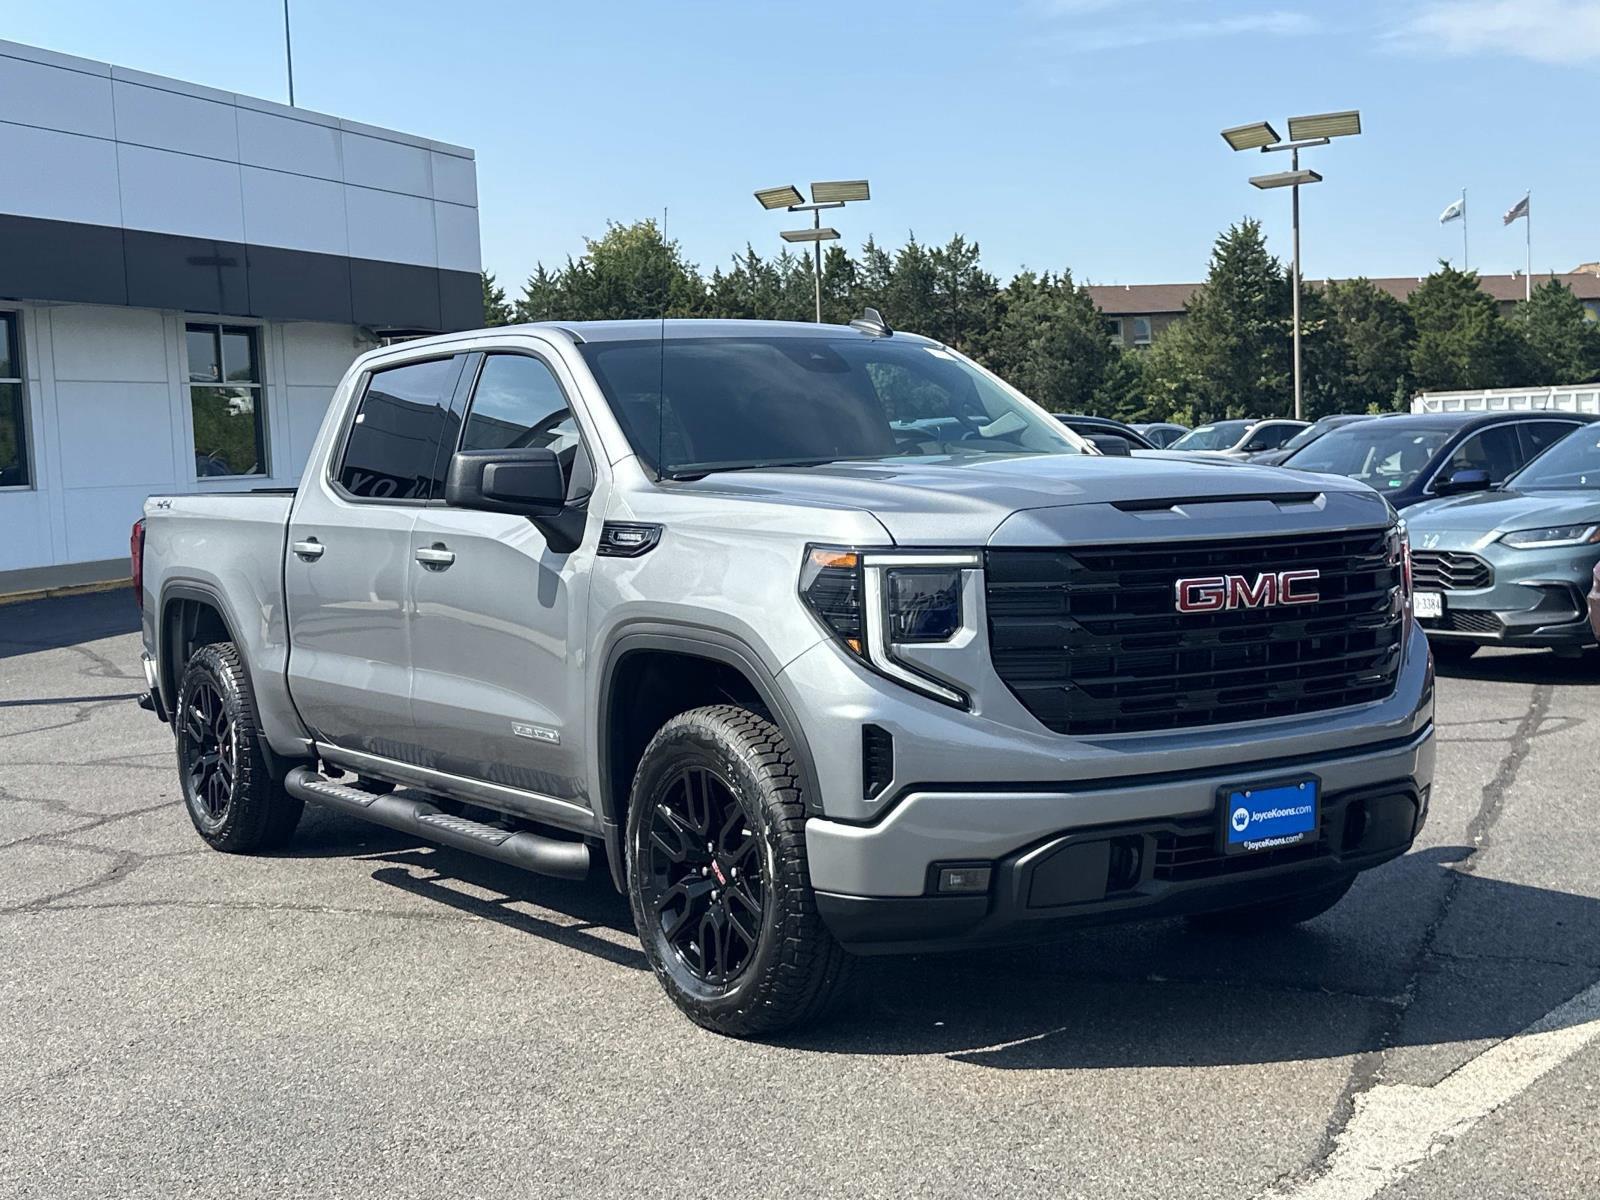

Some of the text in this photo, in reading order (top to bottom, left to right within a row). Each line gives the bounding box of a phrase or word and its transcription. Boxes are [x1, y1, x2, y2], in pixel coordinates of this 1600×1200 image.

[1175, 569, 1320, 612] GMC
[1251, 805, 1312, 822] JoyceKoons.com
[1247, 835, 1300, 851] JoyceKoons.com
